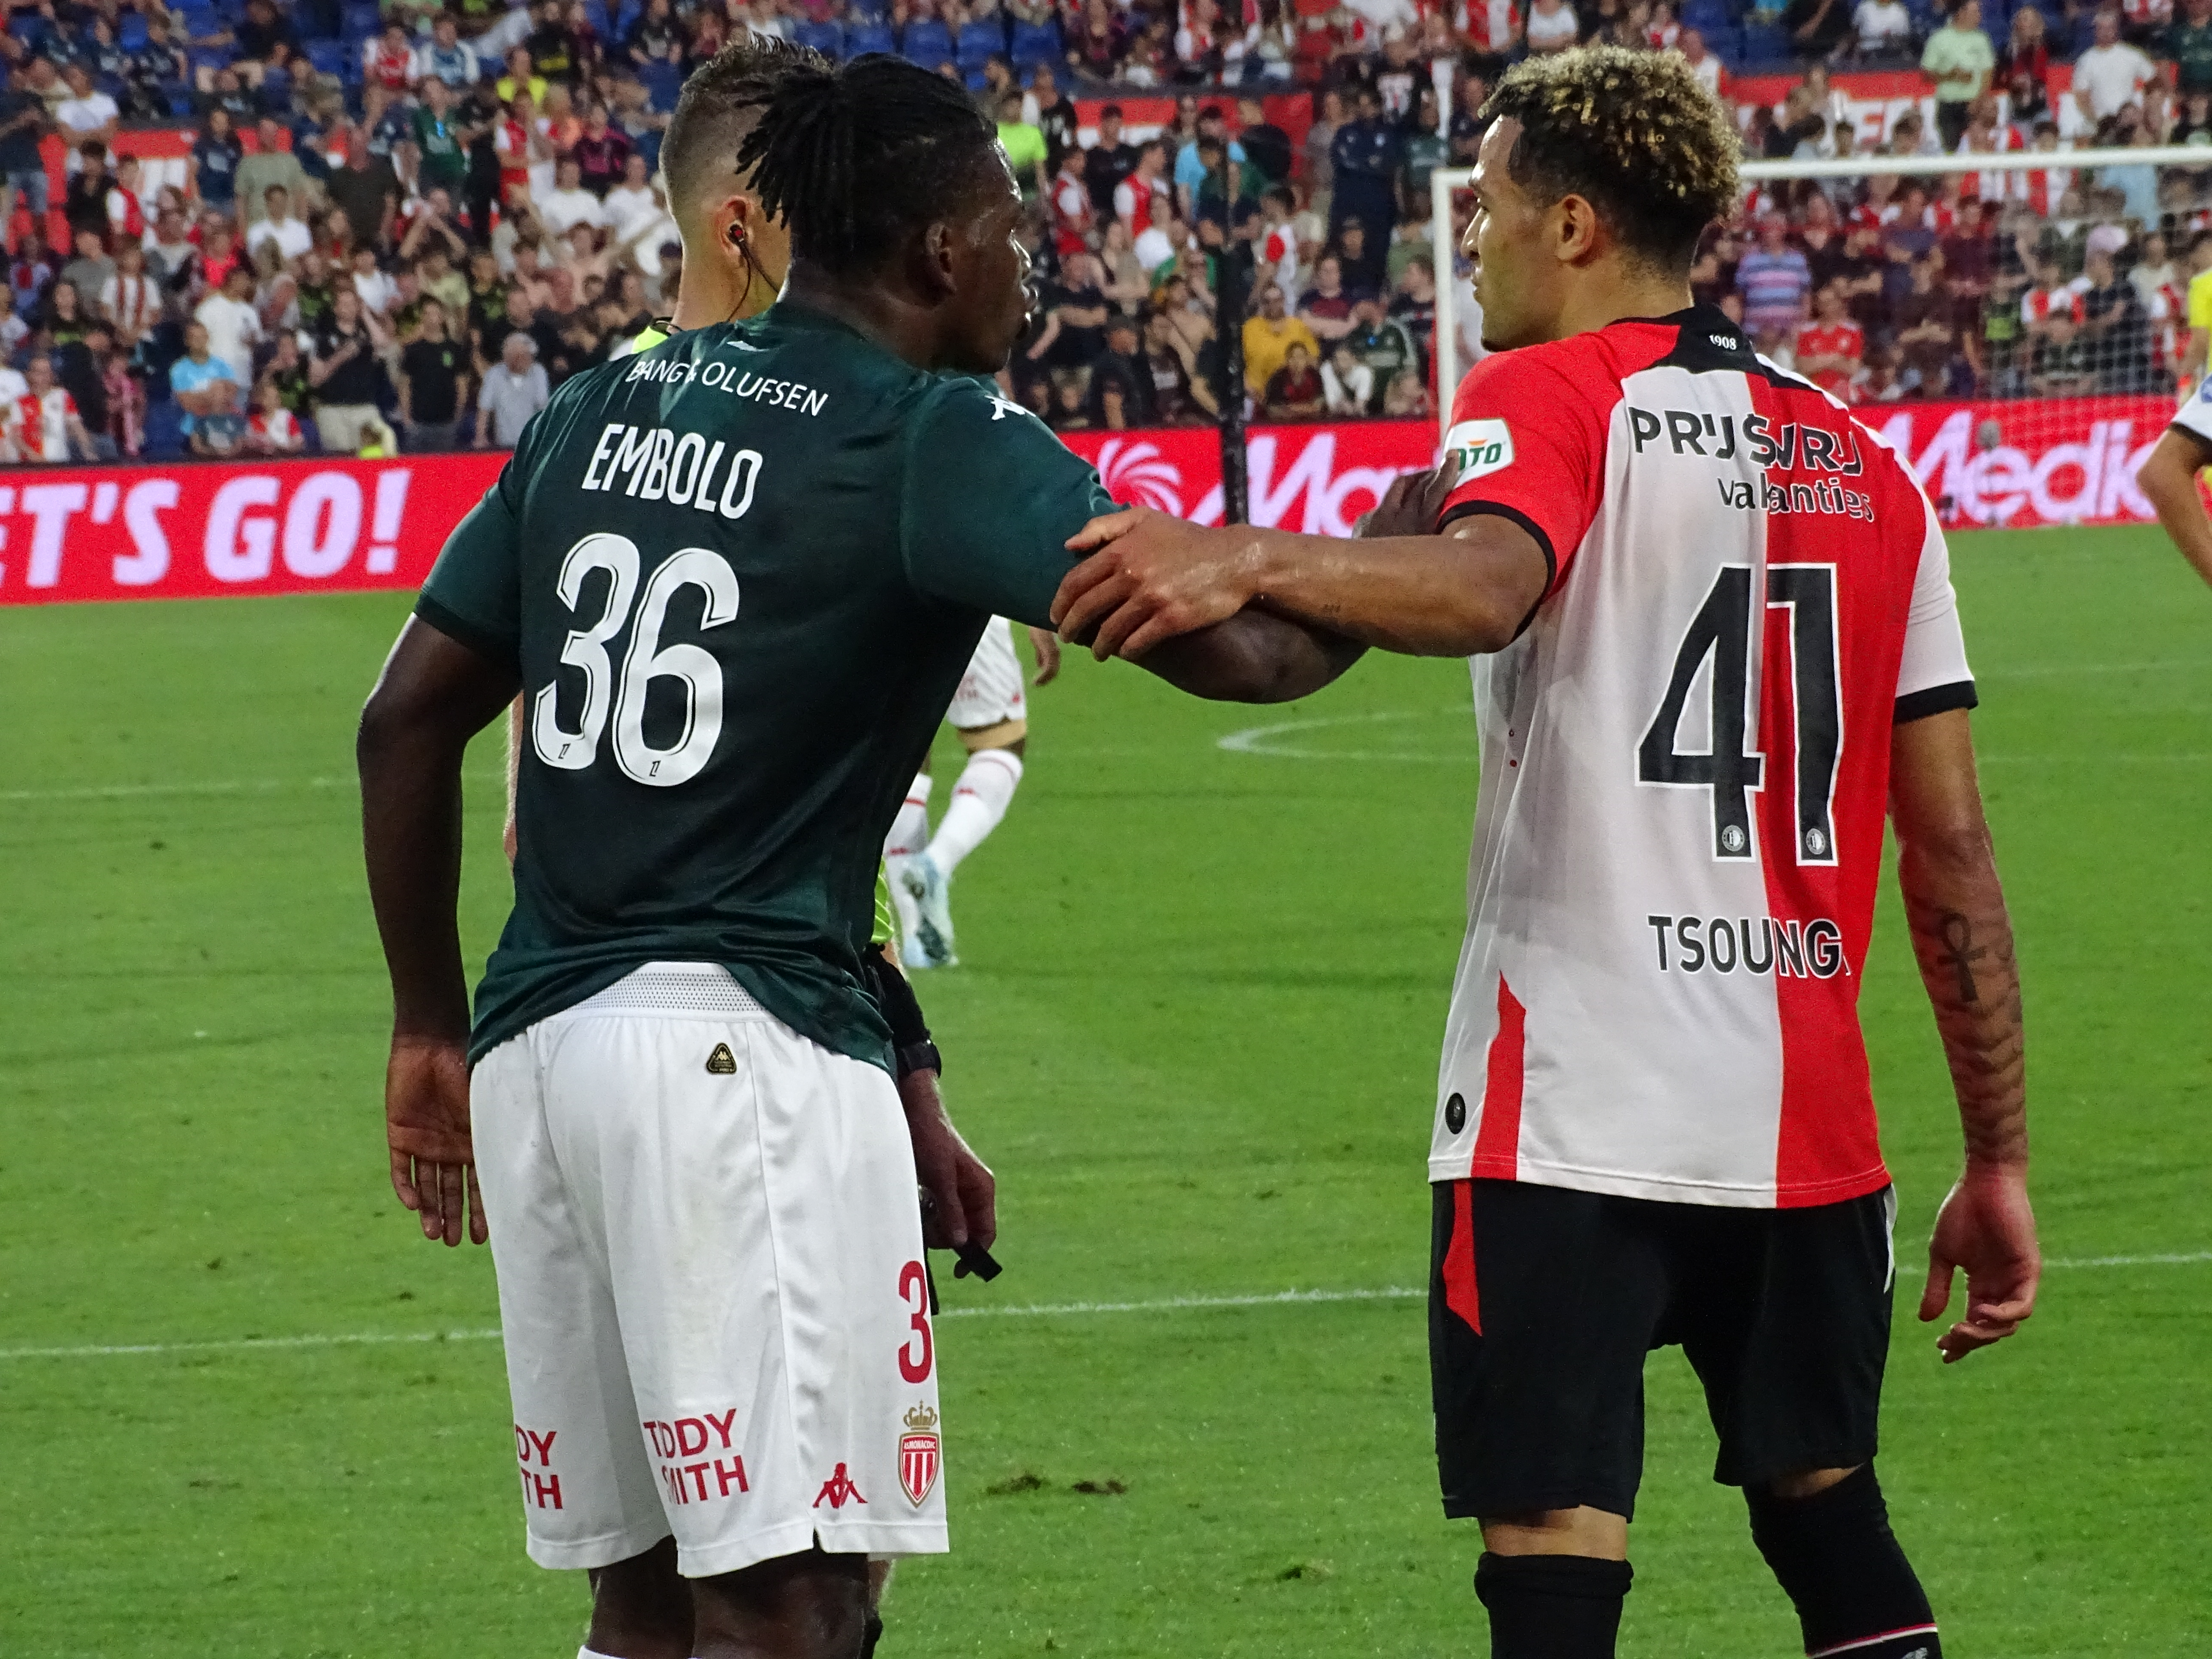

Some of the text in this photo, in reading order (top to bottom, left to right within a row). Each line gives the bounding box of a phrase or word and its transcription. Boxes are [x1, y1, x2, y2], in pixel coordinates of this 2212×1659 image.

[625, 359, 690, 383] BANG
[701, 362, 829, 416] OLUFSEN
[1709, 335, 1737, 350] 1908
[582, 423, 763, 519] EMBOLO
[1717, 471, 1874, 522] vakanties
[204, 469, 413, 582] GO!
[532, 533, 740, 787] 36
[1634, 562, 1845, 867] 41
[1647, 914, 1851, 979] TSOUNG
[899, 1260, 931, 1383] 3
